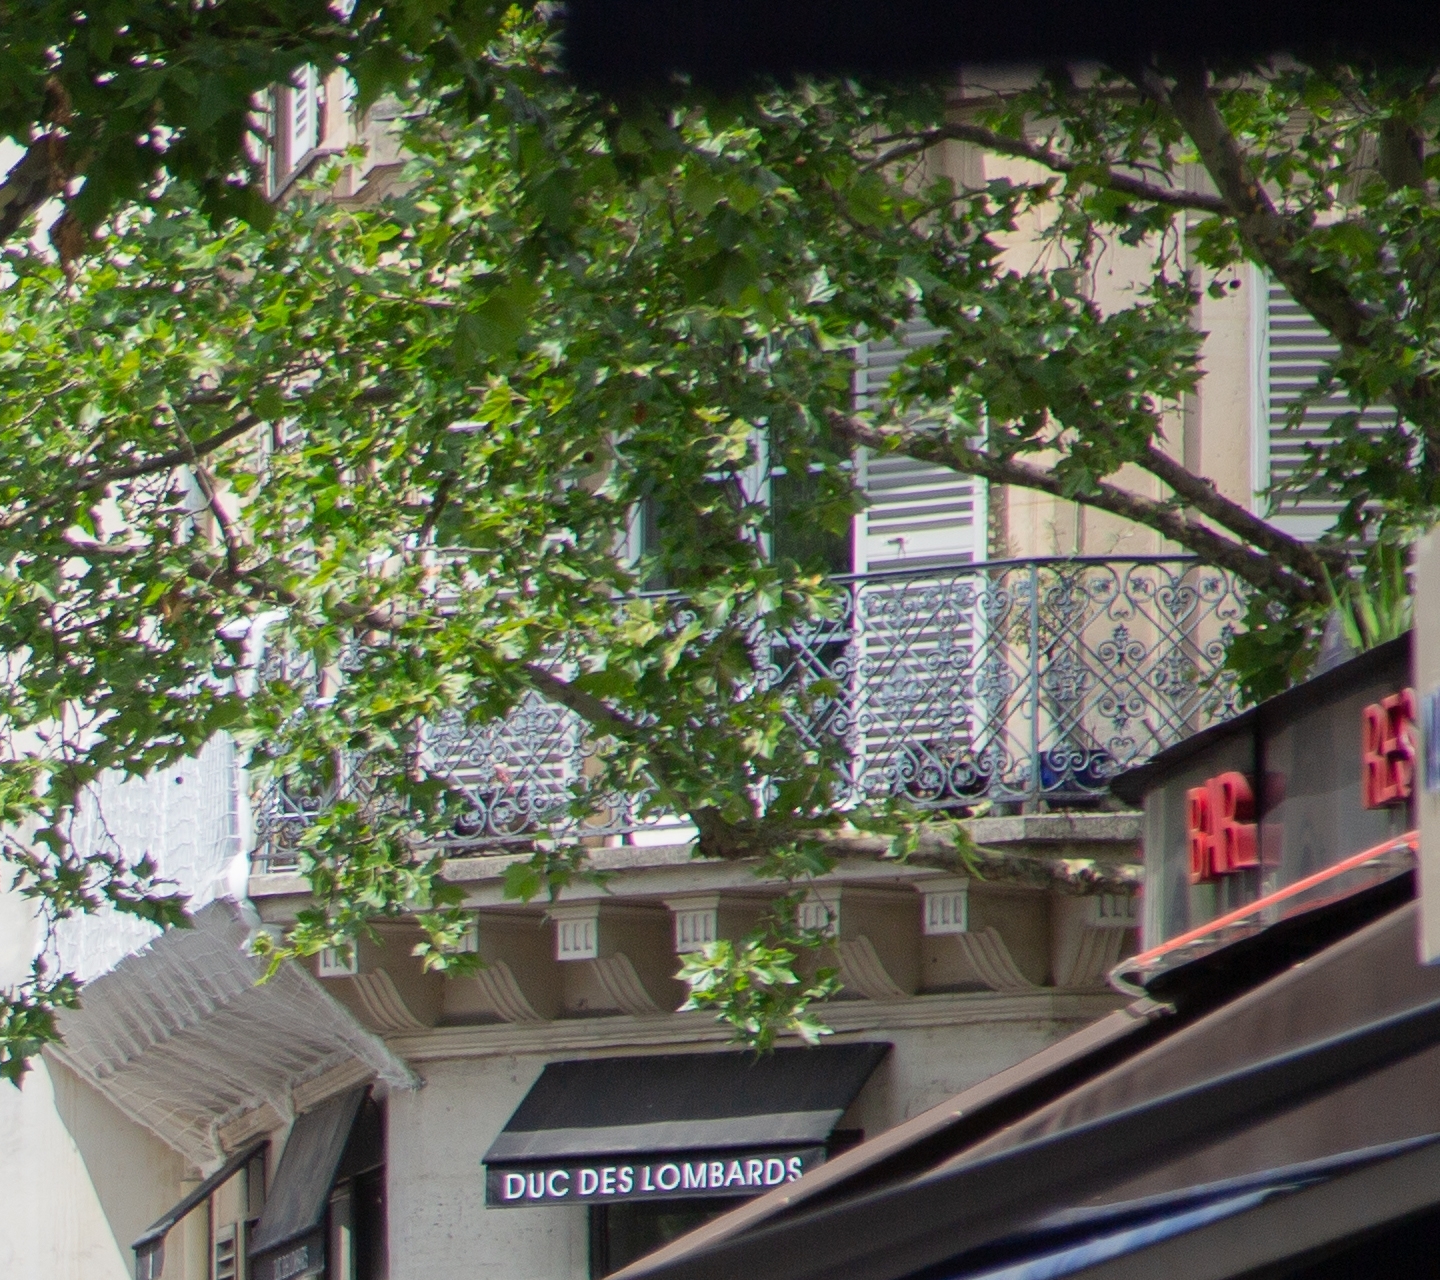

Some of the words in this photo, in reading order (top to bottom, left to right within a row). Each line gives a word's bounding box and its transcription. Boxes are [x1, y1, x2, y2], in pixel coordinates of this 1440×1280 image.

[1188, 771, 1260, 885] BAR
[503, 1171, 570, 1200] DUC
[578, 1166, 634, 1195] DES
[641, 1156, 802, 1192] LOMBARDS
